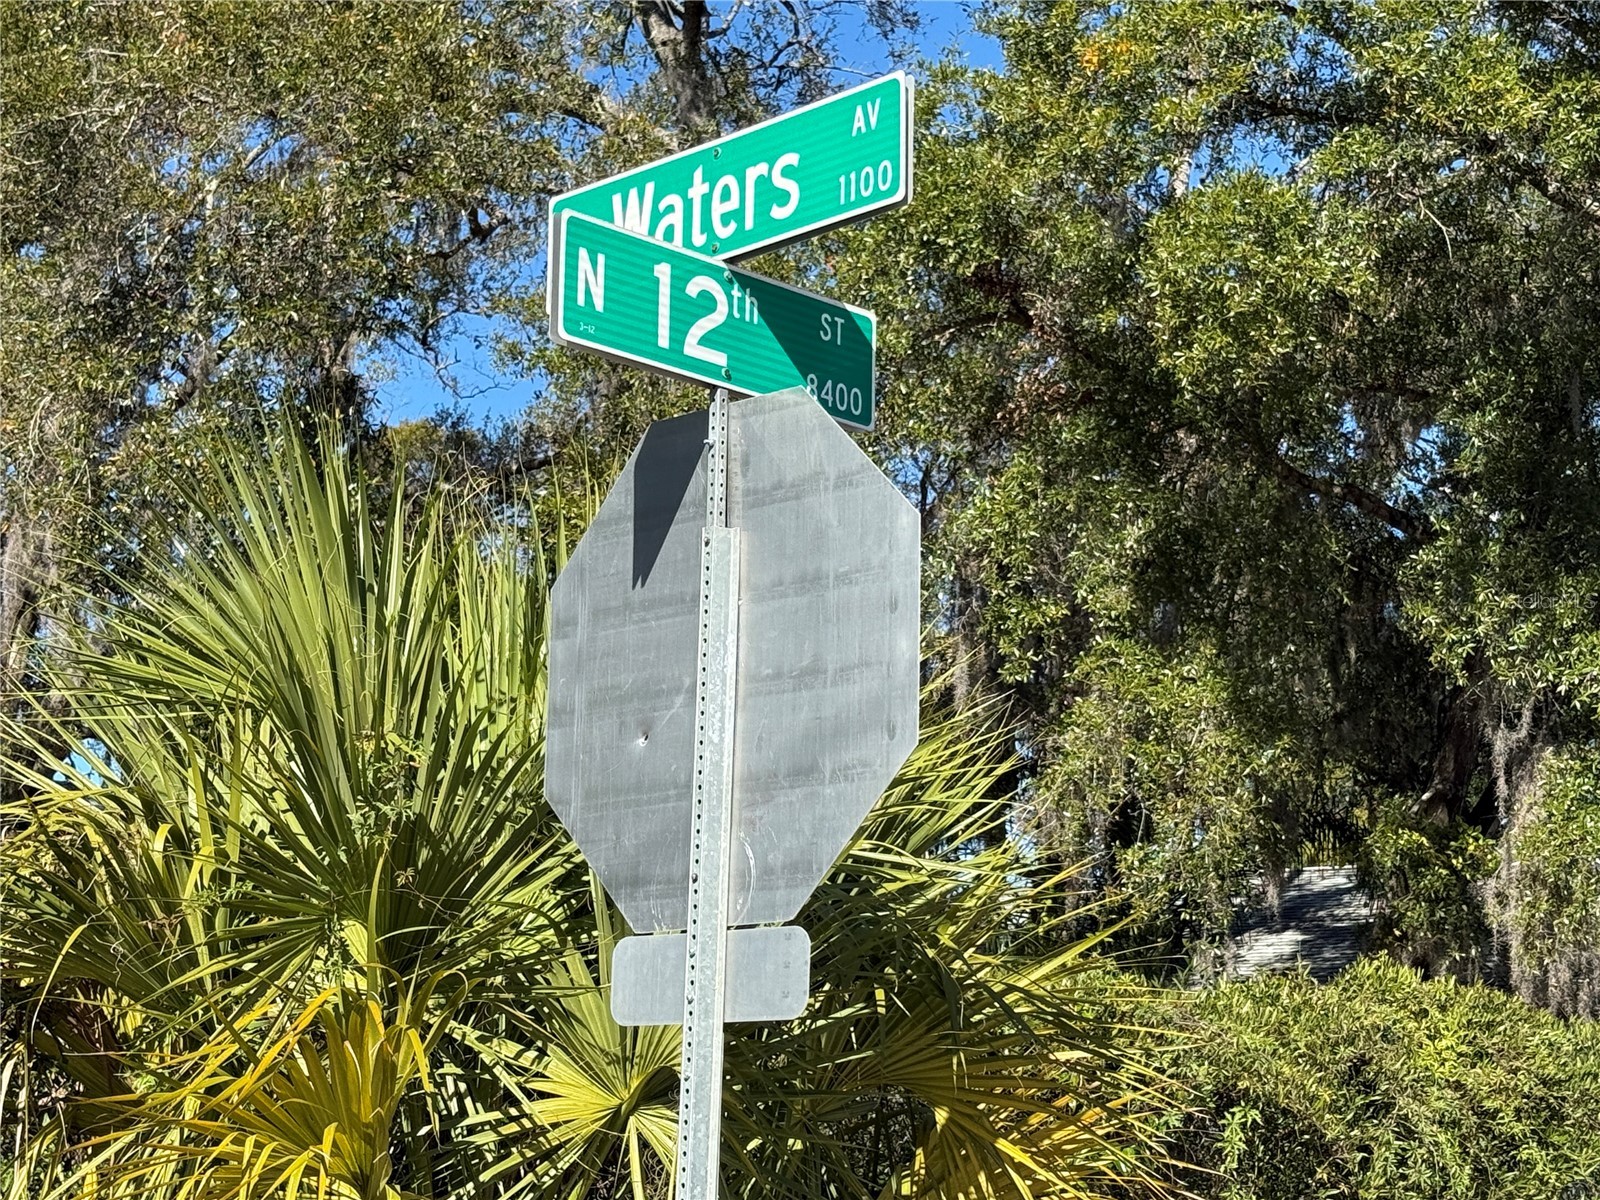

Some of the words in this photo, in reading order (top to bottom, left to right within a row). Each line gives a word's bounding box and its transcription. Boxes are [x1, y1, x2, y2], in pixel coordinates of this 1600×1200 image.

[852, 98, 881, 137] AV
[611, 152, 800, 247] Waters
[838, 159, 893, 205] 1100
[577, 246, 605, 313] N
[653, 262, 758, 367] 12th
[820, 312, 845, 346] ST
[806, 373, 863, 416] 8400
